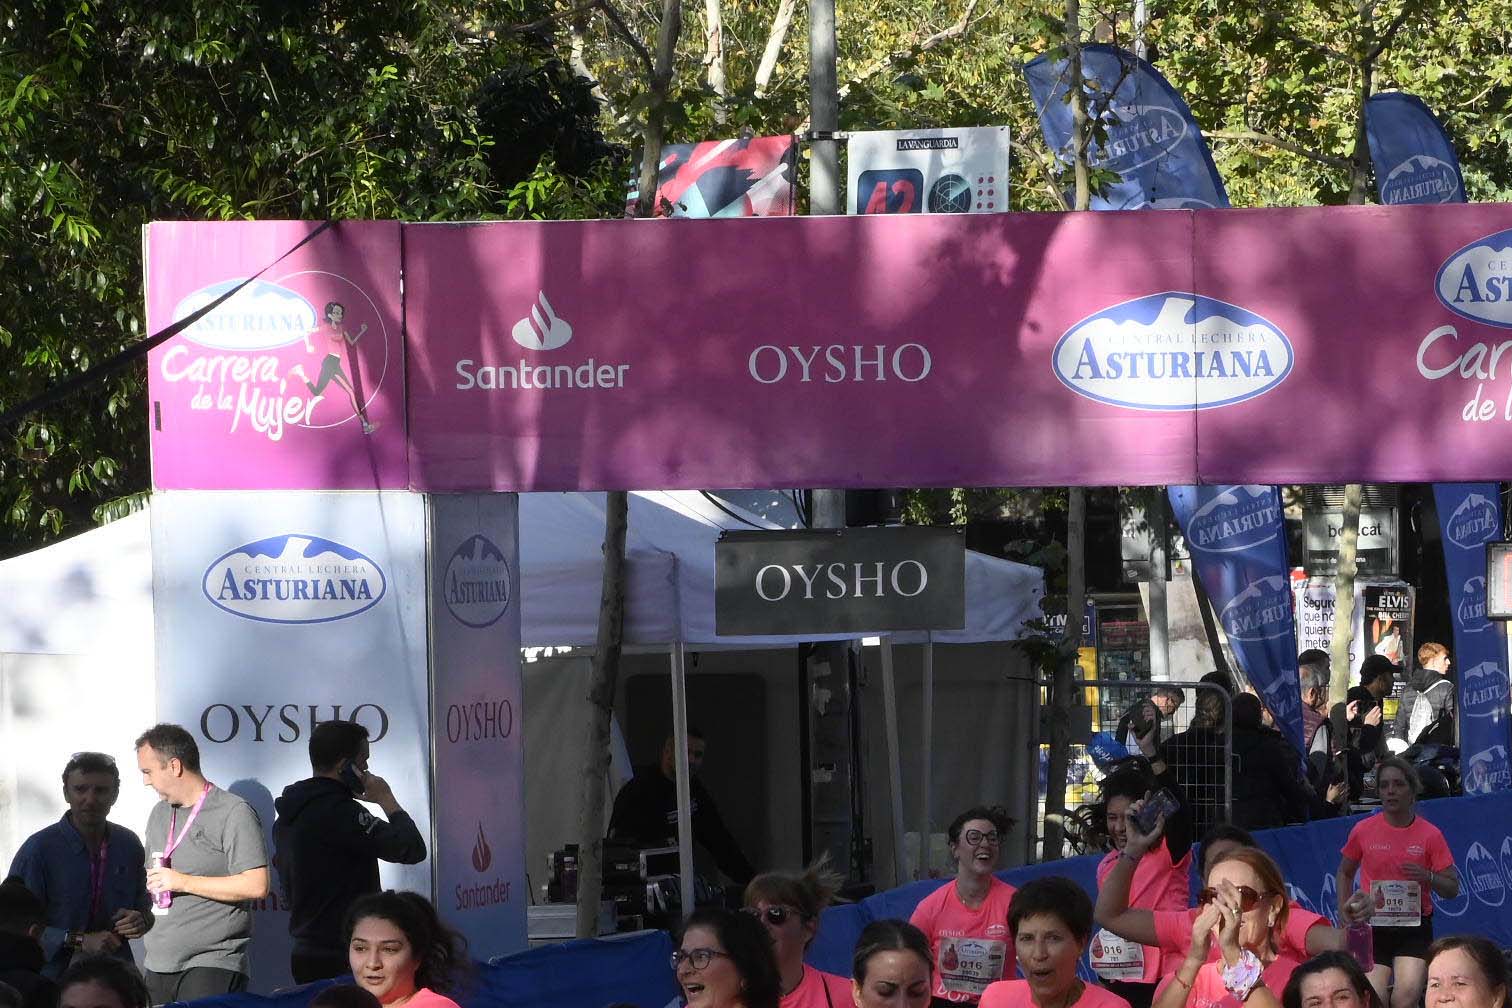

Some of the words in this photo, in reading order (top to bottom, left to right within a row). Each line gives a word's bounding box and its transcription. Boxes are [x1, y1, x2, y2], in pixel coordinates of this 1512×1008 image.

[907, 138, 958, 150] VANGUARDIA
[161, 347, 279, 385] Carrera
[455, 359, 630, 390] Santander
[748, 343, 933, 384] OYSHO
[1072, 343, 1275, 382] ASTURIANA
[1462, 385, 1497, 422] de
[216, 567, 373, 602] ASTURIANA
[244, 565, 304, 575] CENTRAL
[308, 564, 367, 575] LECHERA
[755, 559, 929, 602] OYSHO
[449, 576, 508, 605] ASTURIANA
[1378, 595, 1410, 608] ELVIS
[446, 699, 513, 745] OYSHO
[455, 877, 511, 912] Santander
[1386, 898, 1404, 906] 016
[960, 961, 983, 970] 016
[1104, 945, 1122, 954] 016
